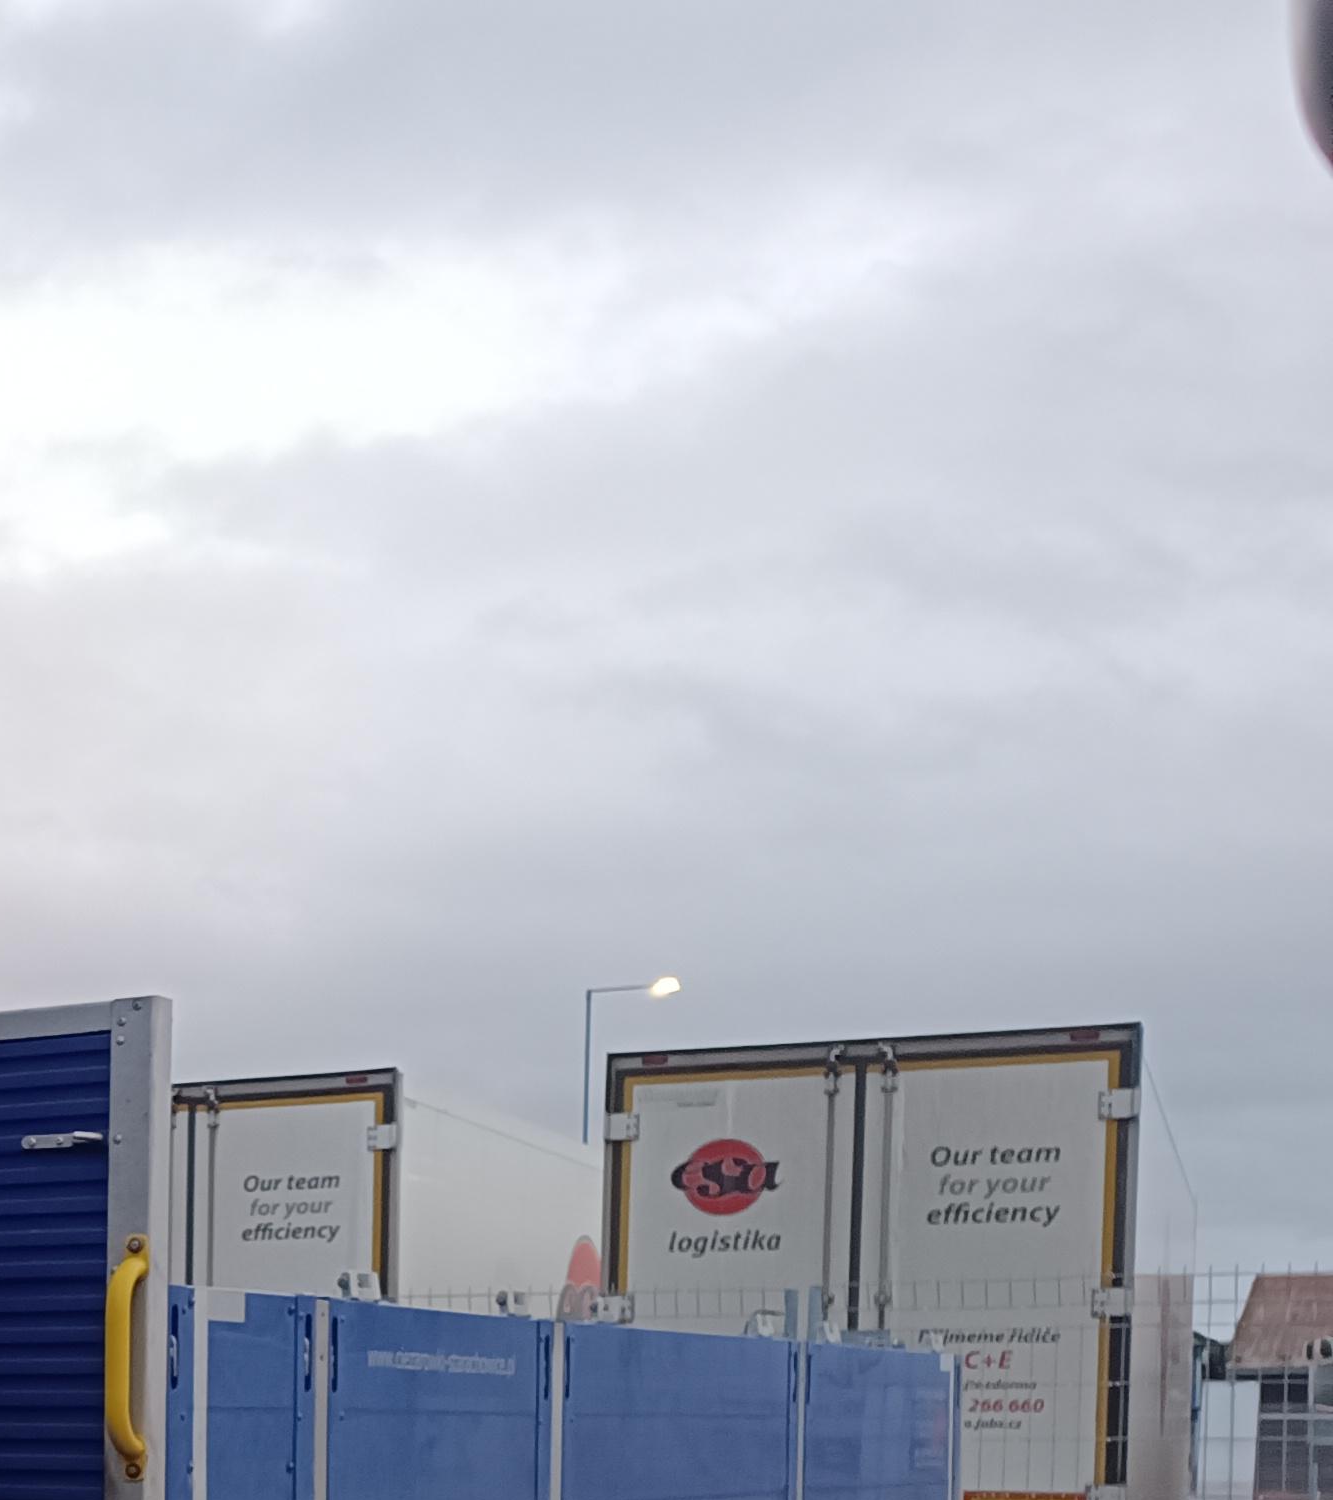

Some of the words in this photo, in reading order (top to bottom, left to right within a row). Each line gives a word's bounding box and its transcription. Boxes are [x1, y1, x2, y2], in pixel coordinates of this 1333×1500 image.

[931, 1146, 982, 1168] Our
[989, 1145, 1061, 1166] team
[243, 1175, 283, 1193] Our
[287, 1174, 341, 1190] team
[938, 1173, 980, 1196] for
[984, 1176, 1052, 1200] your
[250, 1198, 281, 1217] for
[283, 1200, 333, 1220] your
[926, 1201, 1060, 1228] efficiency
[241, 1221, 341, 1243] efficiency
[668, 1228, 782, 1259] logistika
